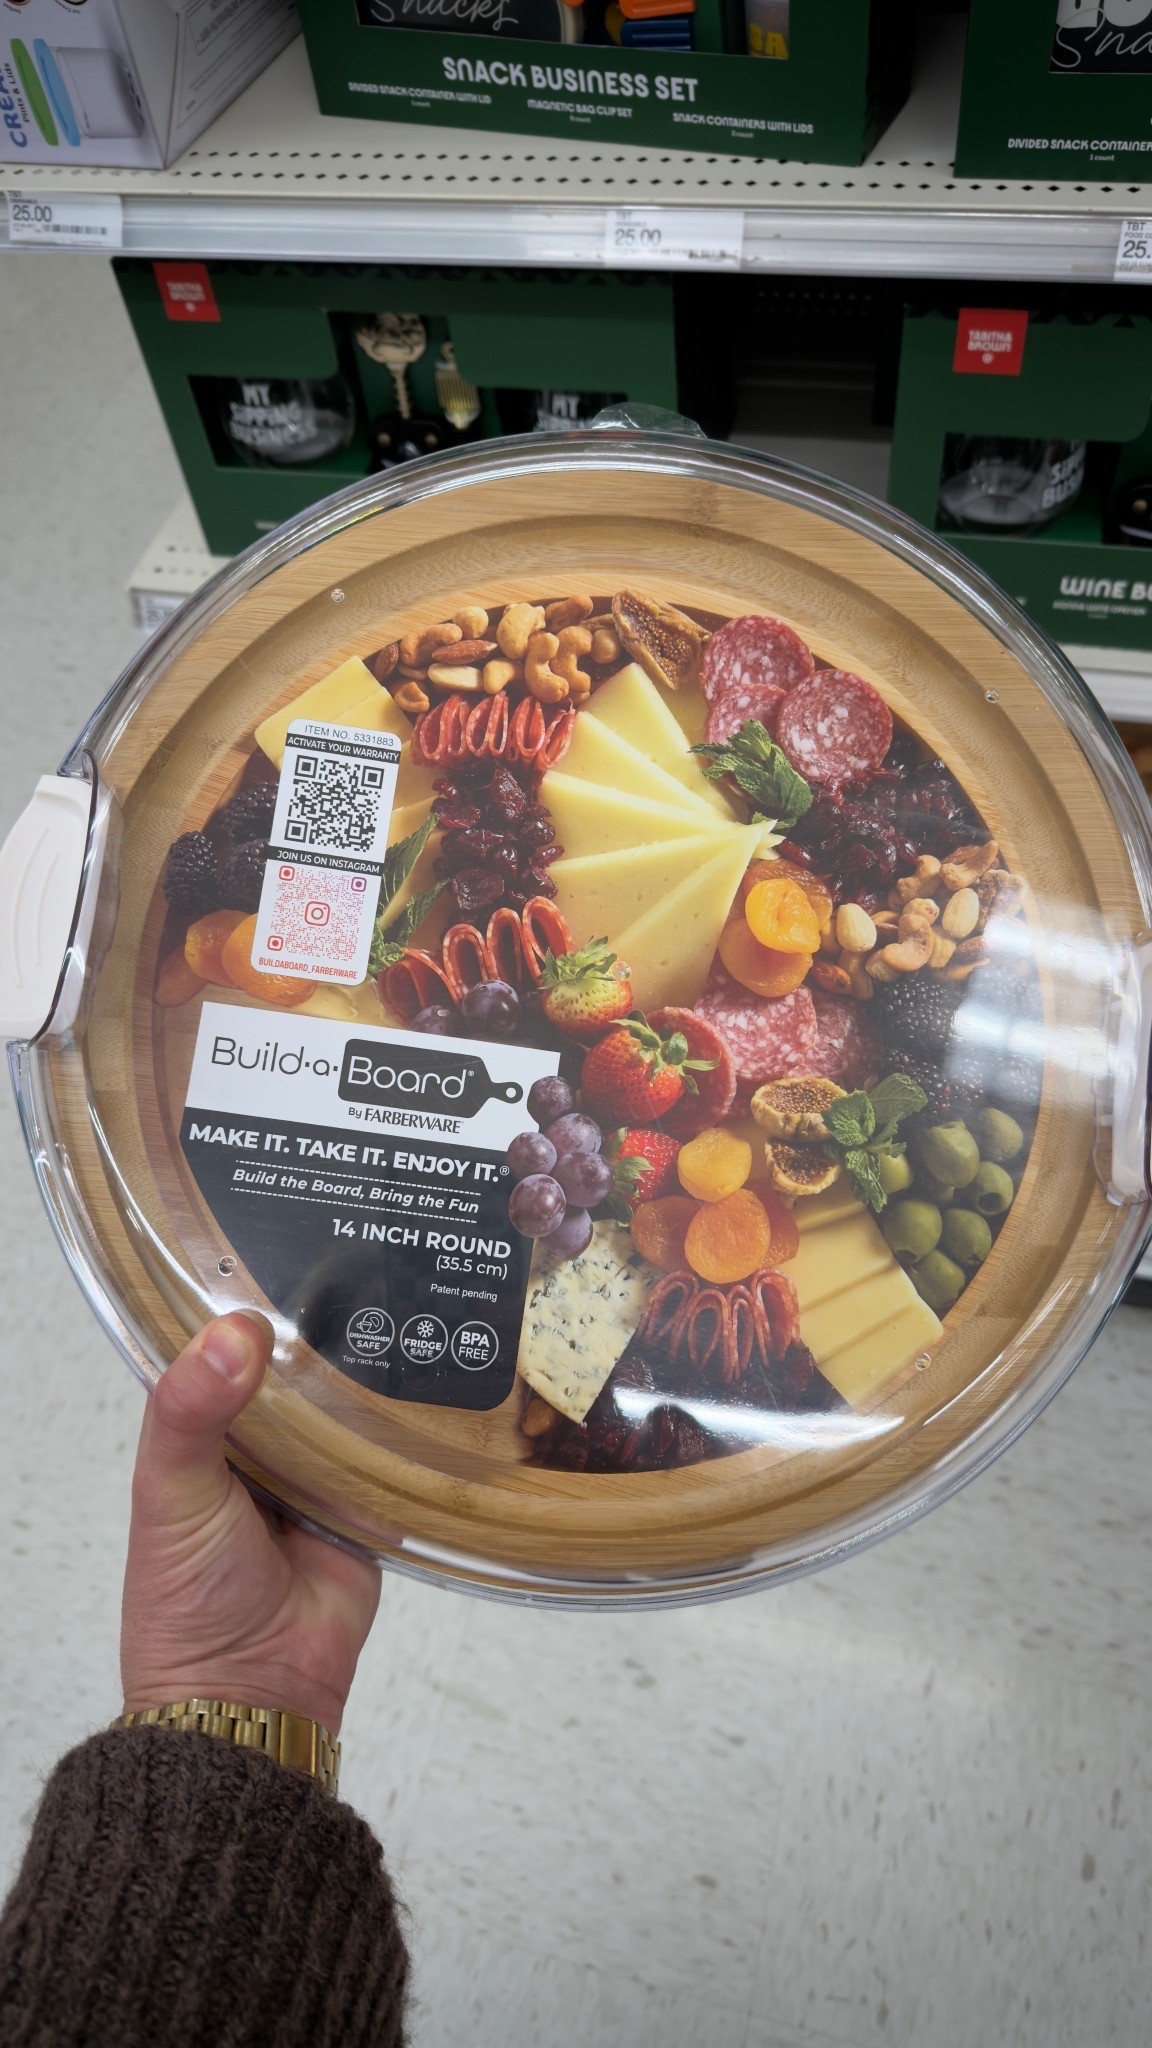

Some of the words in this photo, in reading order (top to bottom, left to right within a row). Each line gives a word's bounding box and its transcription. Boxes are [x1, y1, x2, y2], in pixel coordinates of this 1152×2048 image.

[3, 62, 16, 84] Lids
[442, 56, 527, 86] SNACK
[530, 65, 649, 97] BUSINESS
[655, 75, 698, 102] SET
[527, 99, 575, 113] MAGNETIC
[576, 104, 596, 114] BAG
[596, 105, 616, 116] CLIP
[617, 108, 632, 118] SET
[672, 112, 706, 124] SNACK
[706, 116, 766, 130] CONTAINERS
[767, 120, 792, 132] WITH
[792, 122, 814, 134] LIDS
[1008, 138, 1049, 150] DIVIDED
[1050, 139, 1088, 150] SNACK
[13, 204, 52, 222] 25.00
[1127, 222, 1146, 231] TBT
[968, 329, 1012, 342] TABITHA
[967, 341, 1012, 352] BROWN
[1060, 576, 1128, 600] WINE
[304, 724, 330, 736] ITEM
[332, 730, 350, 740] NO.
[354, 733, 394, 746] 5331883
[287, 736, 326, 750] ACTIVATE
[328, 742, 351, 753] YOUR
[352, 746, 399, 762] WARRANTY
[277, 850, 298, 861] JOIN
[300, 854, 312, 862] US
[314, 856, 328, 865] ON
[330, 858, 380, 874] INSTAGRAM
[258, 957, 358, 980] BUILDABOARD_FARBERWARE
[348, 1107, 362, 1119] By
[364, 1108, 461, 1134] FARBERWARE
[188, 1123, 260, 1150] MAKE
[264, 1134, 290, 1153] IT.
[296, 1138, 357, 1162] TAKE
[361, 1146, 387, 1167] IT.
[393, 1151, 471, 1178] ENJOY
[232, 1168, 278, 1186] Build
[280, 1175, 308, 1190] the
[311, 1179, 364, 1200] Board,
[369, 1187, 413, 1208] Bring
[418, 1194, 444, 1209] the
[448, 1199, 480, 1214] Fun
[332, 1218, 356, 1238] 14
[362, 1223, 420, 1247] INCH
[425, 1231, 512, 1259] ROUND
[436, 1254, 472, 1272] (35.5
[476, 1263, 508, 1280] cm)
[430, 1284, 460, 1296] Patent
[461, 1288, 498, 1303] pending
[349, 1332, 391, 1342] DISHWASHER
[356, 1340, 380, 1350] SAFE
[404, 1338, 442, 1351] FRIDGE
[460, 1331, 490, 1348] BPA
[342, 1354, 356, 1364] Top
[374, 1361, 391, 1369] only
[410, 1348, 434, 1358] SAFE
[458, 1346, 488, 1360] FREE
